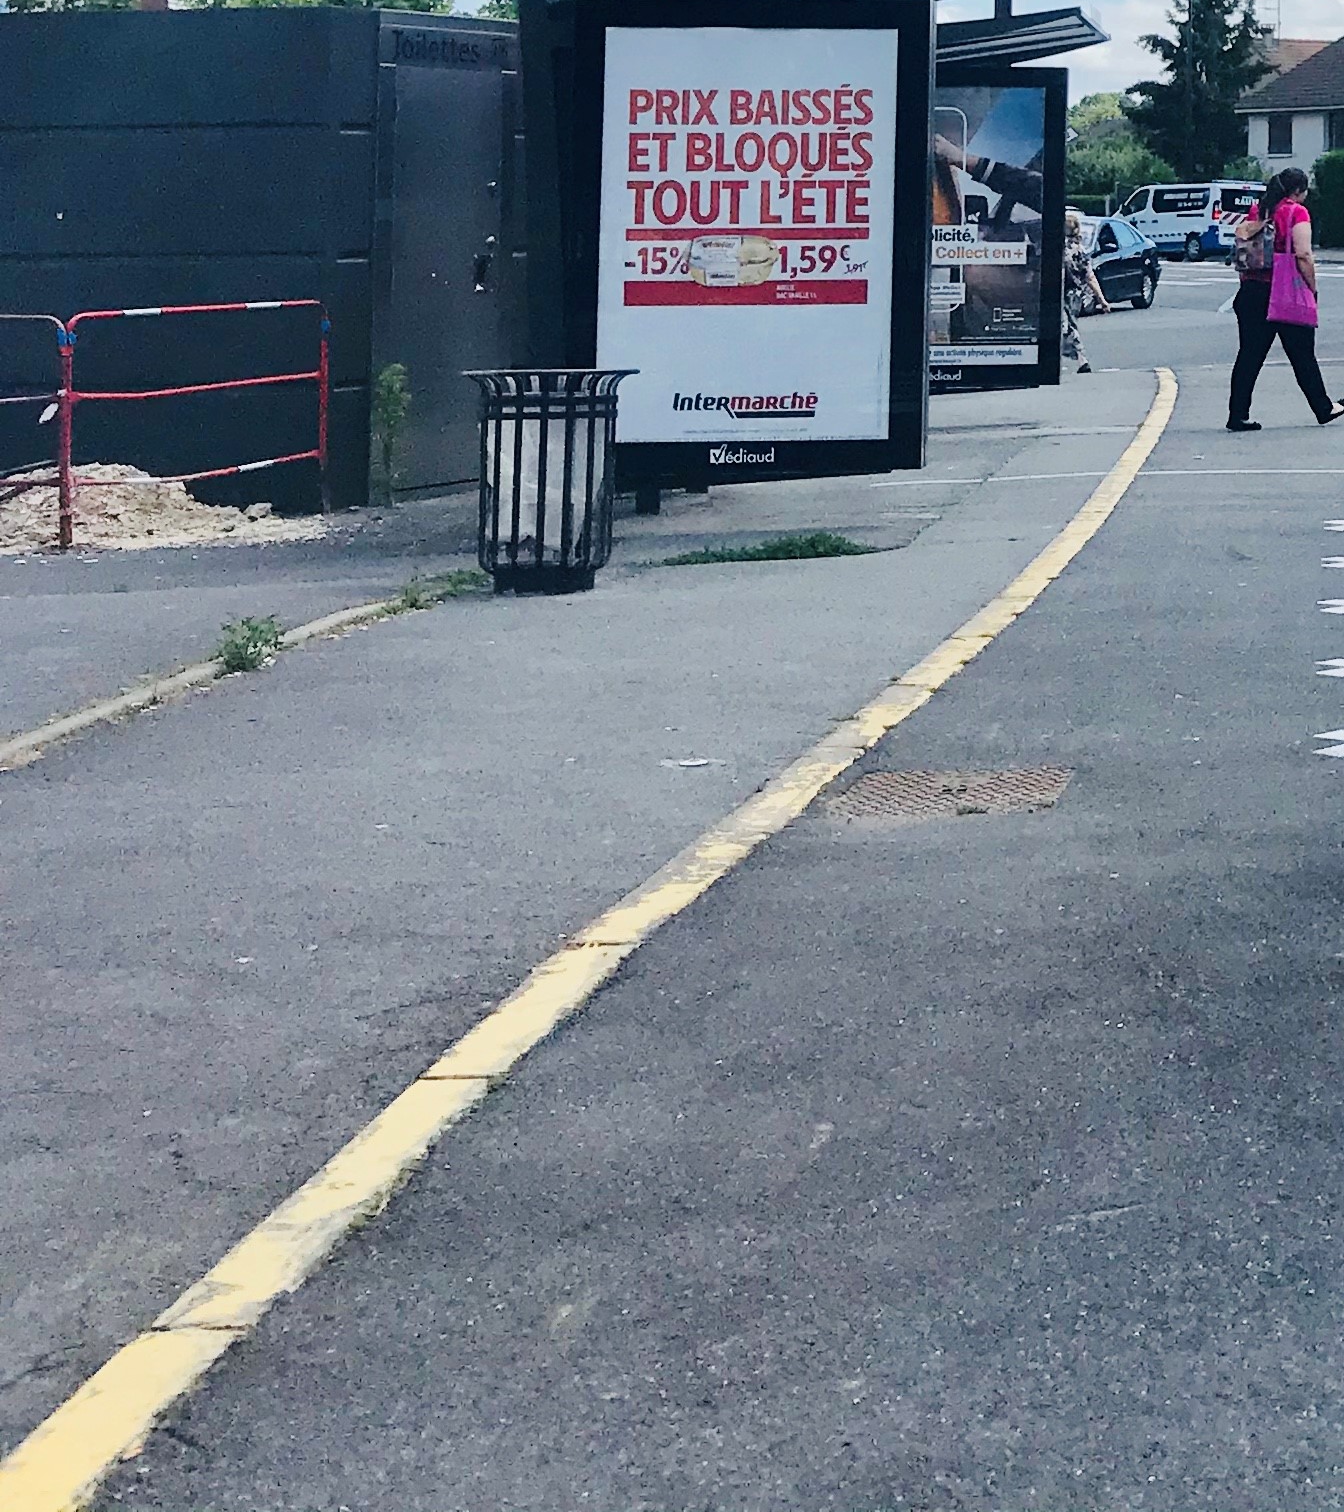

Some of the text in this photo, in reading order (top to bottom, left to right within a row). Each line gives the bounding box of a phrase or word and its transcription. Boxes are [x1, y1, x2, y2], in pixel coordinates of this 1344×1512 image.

[628, 84, 874, 126] PRIX BAISSÉS
[628, 126, 874, 178] ET BLOQUÉS
[626, 173, 871, 225] TOUT L'ÉTÉ
[932, 229, 975, 243] licité,
[624, 246, 690, 276] -15%
[936, 247, 988, 259] Collect
[672, 392, 819, 412] Intermarché
